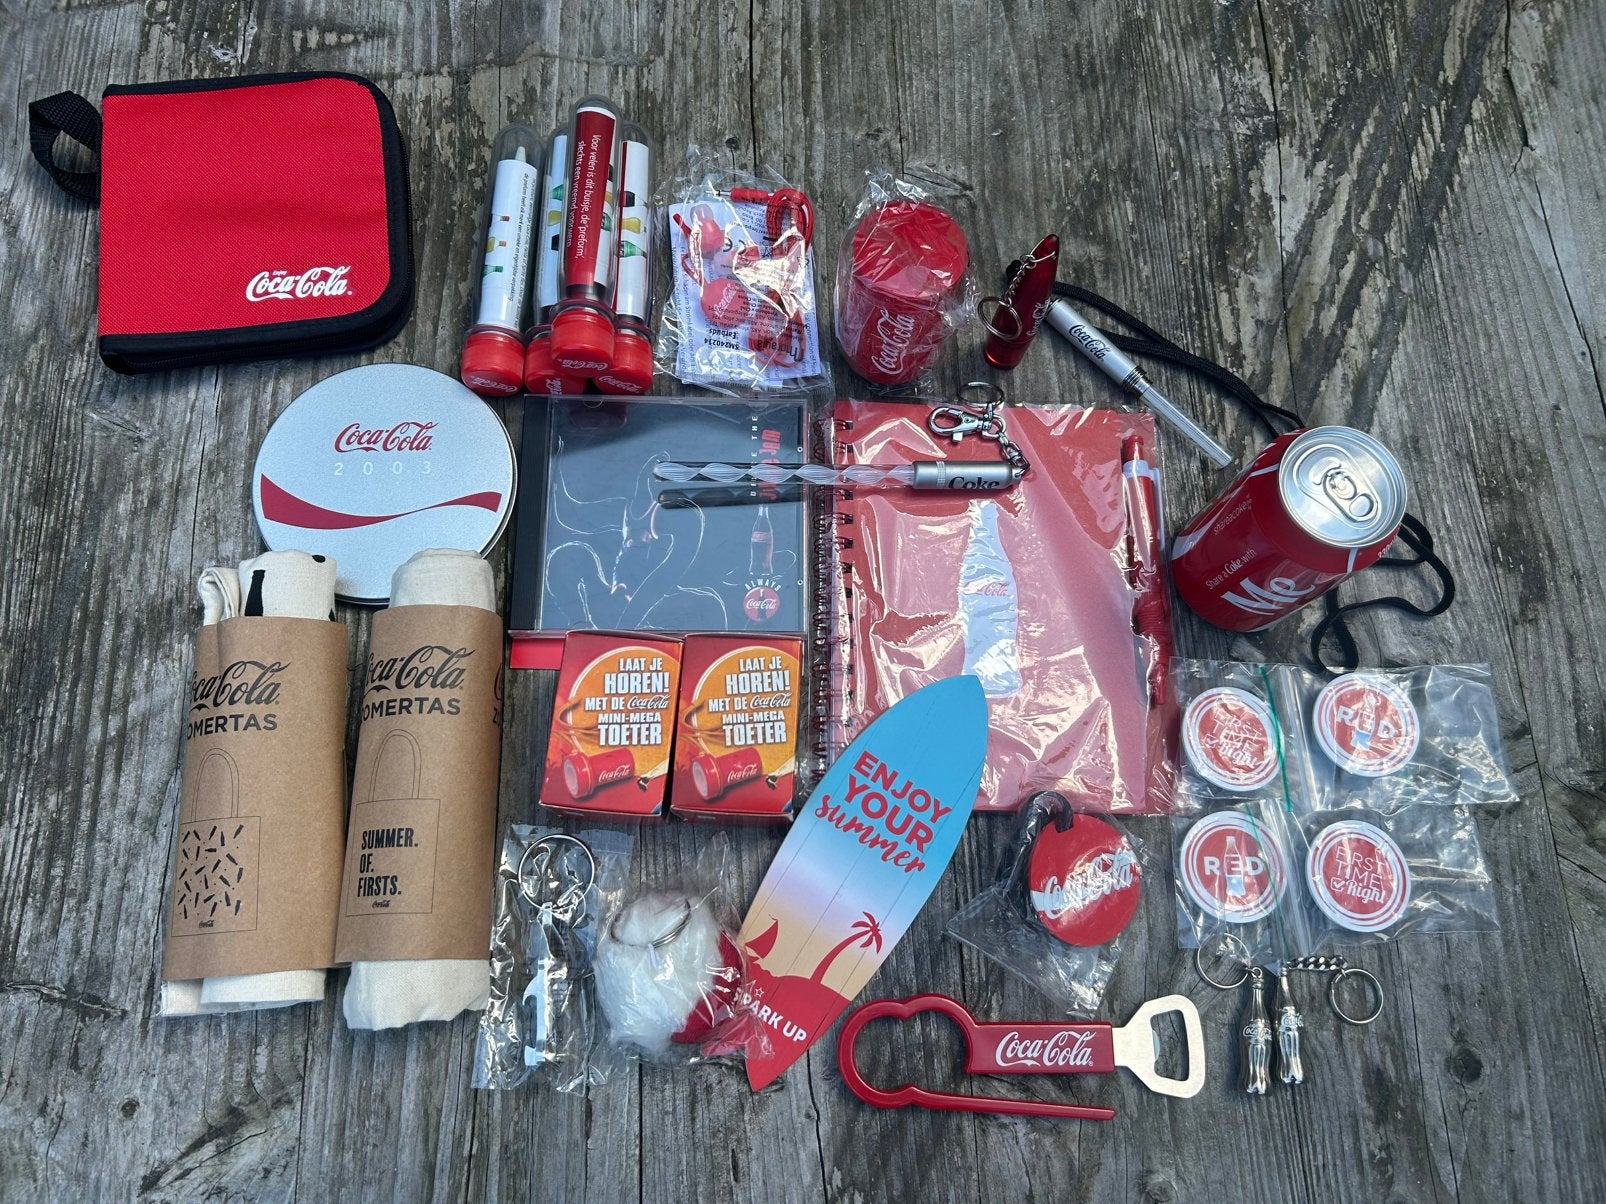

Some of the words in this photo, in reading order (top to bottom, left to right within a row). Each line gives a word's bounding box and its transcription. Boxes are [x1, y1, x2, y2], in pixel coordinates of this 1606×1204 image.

[590, 133, 601, 151] Voor
[575, 140, 586, 165] slechts
[587, 151, 598, 170] velen
[573, 166, 581, 180] een
[584, 178, 594, 189] dit
[569, 180, 581, 210] vreemd
[579, 189, 593, 213] buisje,
[579, 214, 589, 223] de
[246, 266, 351, 302] Coca-Cola
[708, 328, 737, 339] Earbuds
[870, 307, 915, 374] Coca-Cola
[1069, 324, 1110, 362] Coca-Cola
[704, 338, 740, 350] SM240214
[561, 359, 608, 371] Coca-Cola
[473, 376, 518, 393] Coca-Cola
[334, 421, 438, 453] Coca-Cola
[334, 461, 432, 476] 2003
[949, 476, 999, 489] Coke
[1242, 549, 1257, 563] with
[1222, 570, 1228, 578] a
[1224, 559, 1243, 574] Coke
[745, 579, 782, 591] ALWAYS
[1205, 574, 1223, 590] Share
[746, 598, 777, 609] Coca-Cola
[1220, 577, 1315, 615] Me
[619, 658, 646, 671] LAAT
[649, 658, 663, 671] JE
[740, 658, 765, 671] LAAT
[768, 656, 782, 670] JE
[604, 672, 669, 694] HOREN!
[726, 671, 790, 695] HOREN!
[362, 697, 461, 721] OMERTAS
[585, 697, 607, 711] MET
[611, 697, 625, 710] DE
[627, 695, 671, 710] Coca-Cola
[708, 698, 731, 712] MET
[734, 697, 747, 710] DE
[750, 692, 792, 709] Coca-Cola
[187, 714, 278, 740] OMERTAS
[598, 712, 662, 723] MINI-MEGA
[722, 711, 785, 723] MINI-MEGA
[598, 724, 662, 746] TOETER
[723, 722, 787, 747] TOETER
[598, 764, 630, 781] Coca-Cola
[728, 764, 757, 782] Coca-Cola
[852, 751, 953, 824] ENJOY
[844, 774, 934, 853] YOUR
[361, 828, 418, 850] SUMMER.
[815, 794, 926, 874] summer
[359, 853, 374, 873] OF.
[1203, 855, 1268, 878] RED
[357, 875, 402, 897] FIRSTS.
[1346, 880, 1386, 904] Right
[783, 1021, 807, 1042] UP
[995, 1031, 1097, 1067] Coca-Cola
